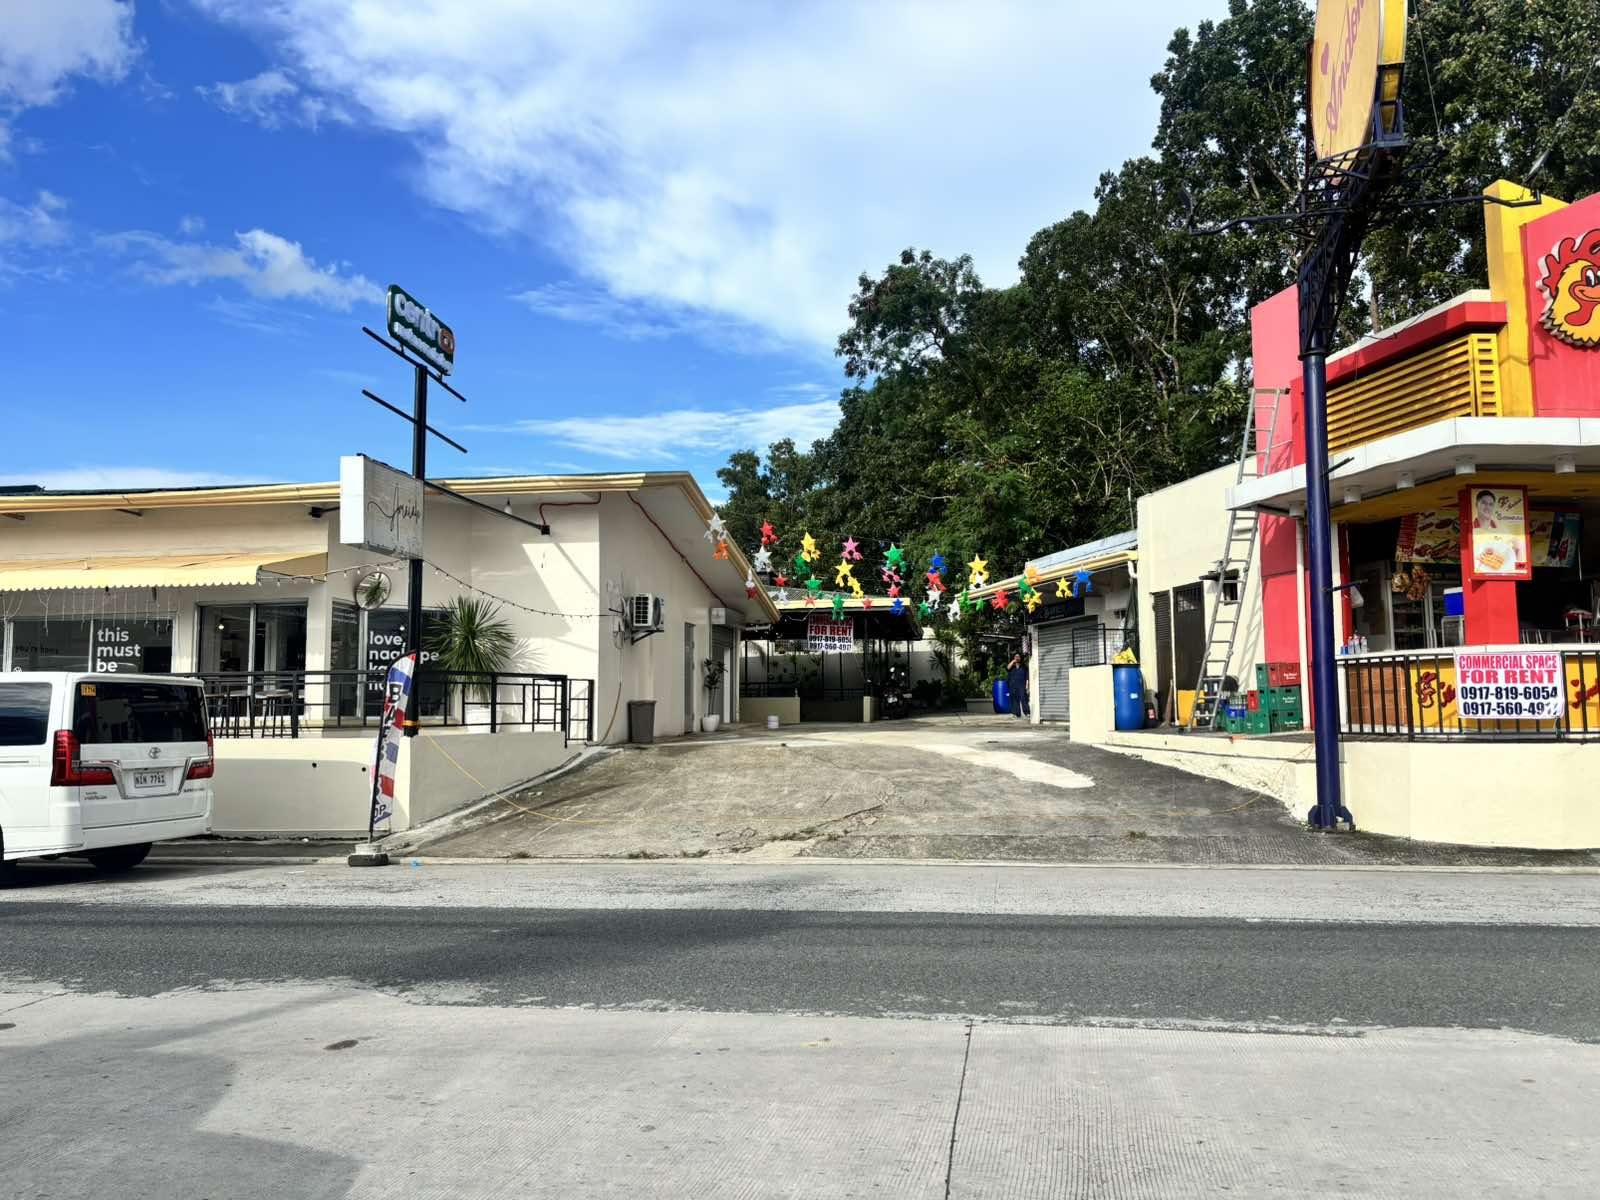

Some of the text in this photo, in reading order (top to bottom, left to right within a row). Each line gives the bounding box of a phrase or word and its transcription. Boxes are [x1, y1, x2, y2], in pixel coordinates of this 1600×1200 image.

[97, 627, 129, 642] this
[809, 625, 852, 636] FOR RENT
[369, 631, 406, 648] love,
[97, 643, 141, 657] must
[96, 658, 118, 673] be
[1459, 655, 1557, 669] COMMERCIAL SPACE
[1460, 670, 1557, 684] FOR RENT
[1460, 686, 1558, 700] 0917-819-6054
